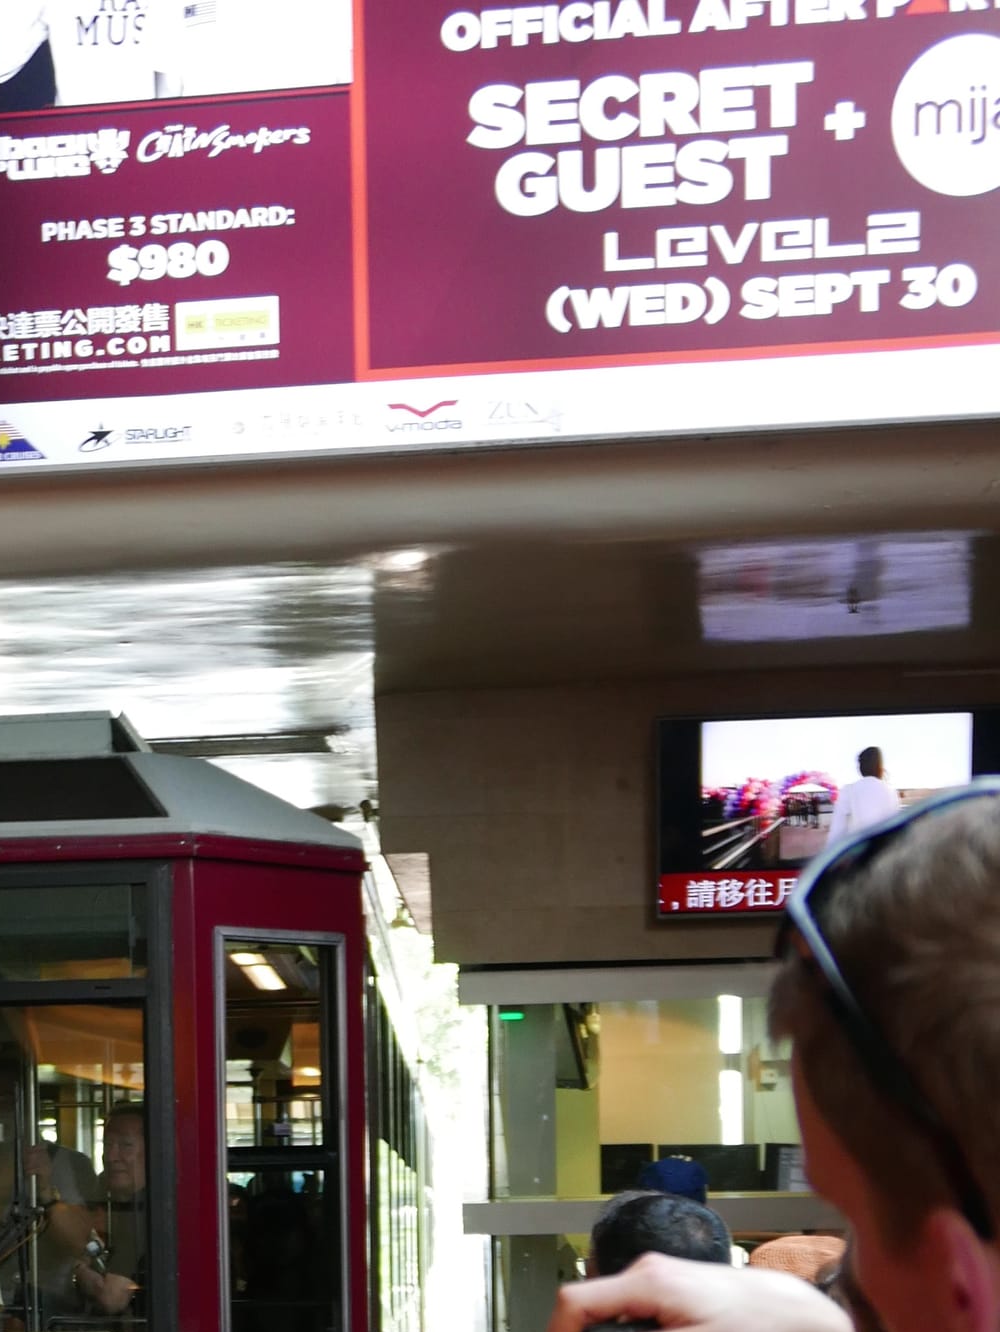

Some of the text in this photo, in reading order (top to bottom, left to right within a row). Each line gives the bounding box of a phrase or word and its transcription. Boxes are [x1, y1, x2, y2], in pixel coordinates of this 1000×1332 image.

[440, 4, 681, 52] OFFICIAL
[466, 61, 814, 149] SECRET
[494, 134, 789, 217] GUEST
[41, 206, 295, 243] PHASE 3 STANDARD:
[106, 240, 230, 286] $980
[546, 263, 978, 333] (WED) SEPT 30
